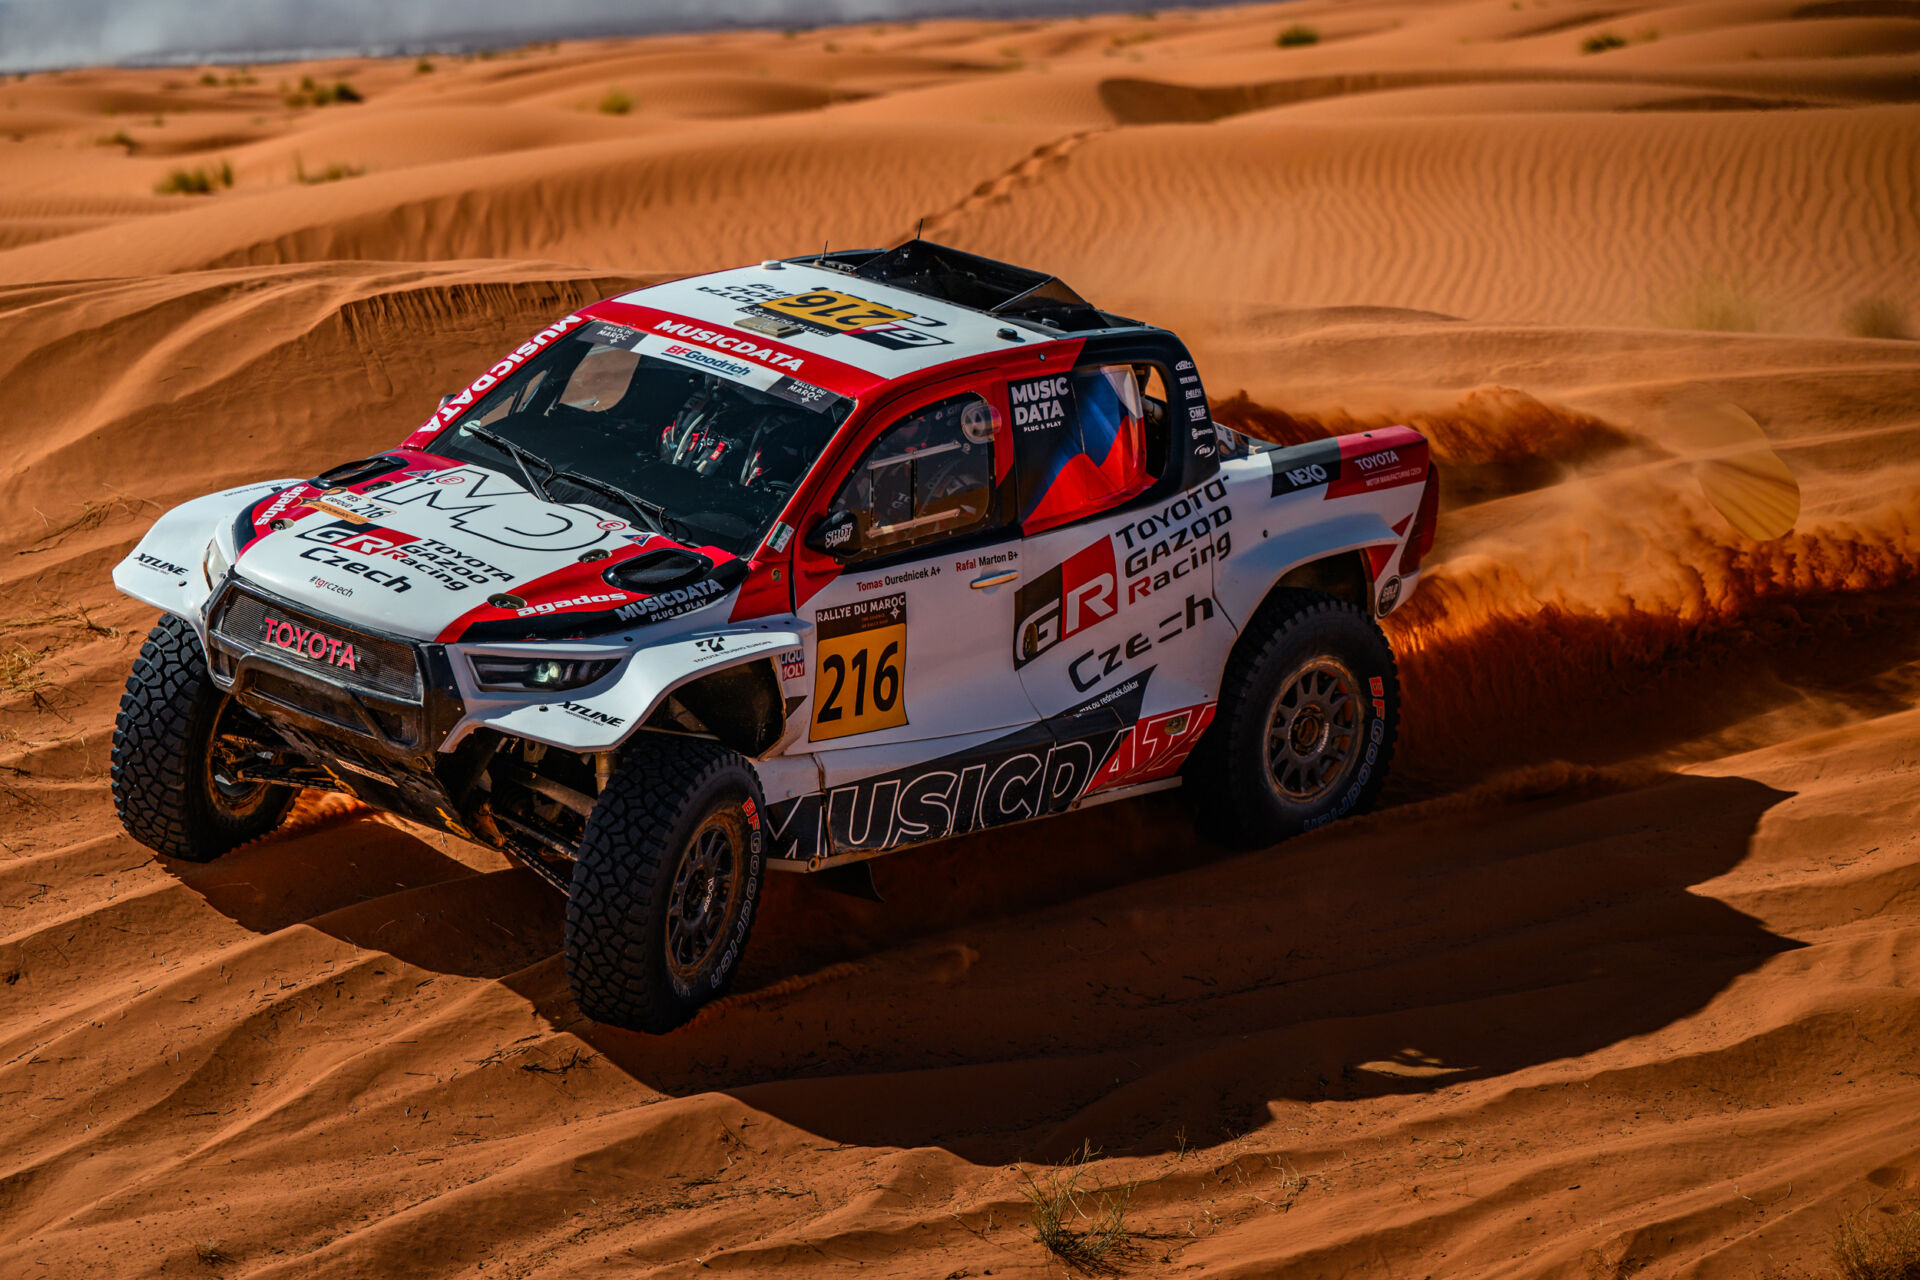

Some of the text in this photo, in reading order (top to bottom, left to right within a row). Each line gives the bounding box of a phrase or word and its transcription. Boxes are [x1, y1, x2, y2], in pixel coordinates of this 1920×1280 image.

[778, 294, 898, 327] 216
[597, 329, 630, 341] MAROC
[653, 319, 804, 372] MUSICDATA
[417, 315, 582, 433] MUSICDATA
[664, 345, 751, 376] BFGoodrich
[787, 384, 822, 401] MAROC
[793, 380, 828, 396] RALLYE DU
[1011, 377, 1070, 405] MUSIC
[1014, 399, 1065, 426] DATA
[1190, 408, 1206, 419] OMP
[1023, 425, 1040, 433] PLUG
[1046, 420, 1062, 428] PLAY
[1355, 450, 1400, 471] TOYOTA
[1285, 464, 1328, 487] NEXO
[254, 486, 309, 525] agados
[349, 503, 392, 518] 216
[304, 527, 395, 554] GR
[133, 553, 189, 576] XTLINE
[300, 547, 413, 593] Czech
[381, 550, 469, 591] Racing
[400, 545, 490, 584] GAZOO
[422, 538, 515, 582] TOYOTA
[955, 551, 1018, 572] Rafal Marton B+
[1128, 531, 1231, 605] Racing
[309, 576, 354, 597] #tgrczech
[856, 565, 941, 592] Tomas Ourednicek A+
[517, 592, 629, 617] agados
[614, 578, 725, 622] MUSICDATA
[651, 598, 707, 622] PLUG & PLAY
[817, 605, 852, 622] RALLYE
[854, 602, 868, 616] DU
[870, 594, 905, 612] MAROC
[1016, 573, 1116, 661] GR
[264, 617, 357, 672] TOYOTA
[817, 640, 899, 724] 216
[557, 700, 626, 727] XTLINE
